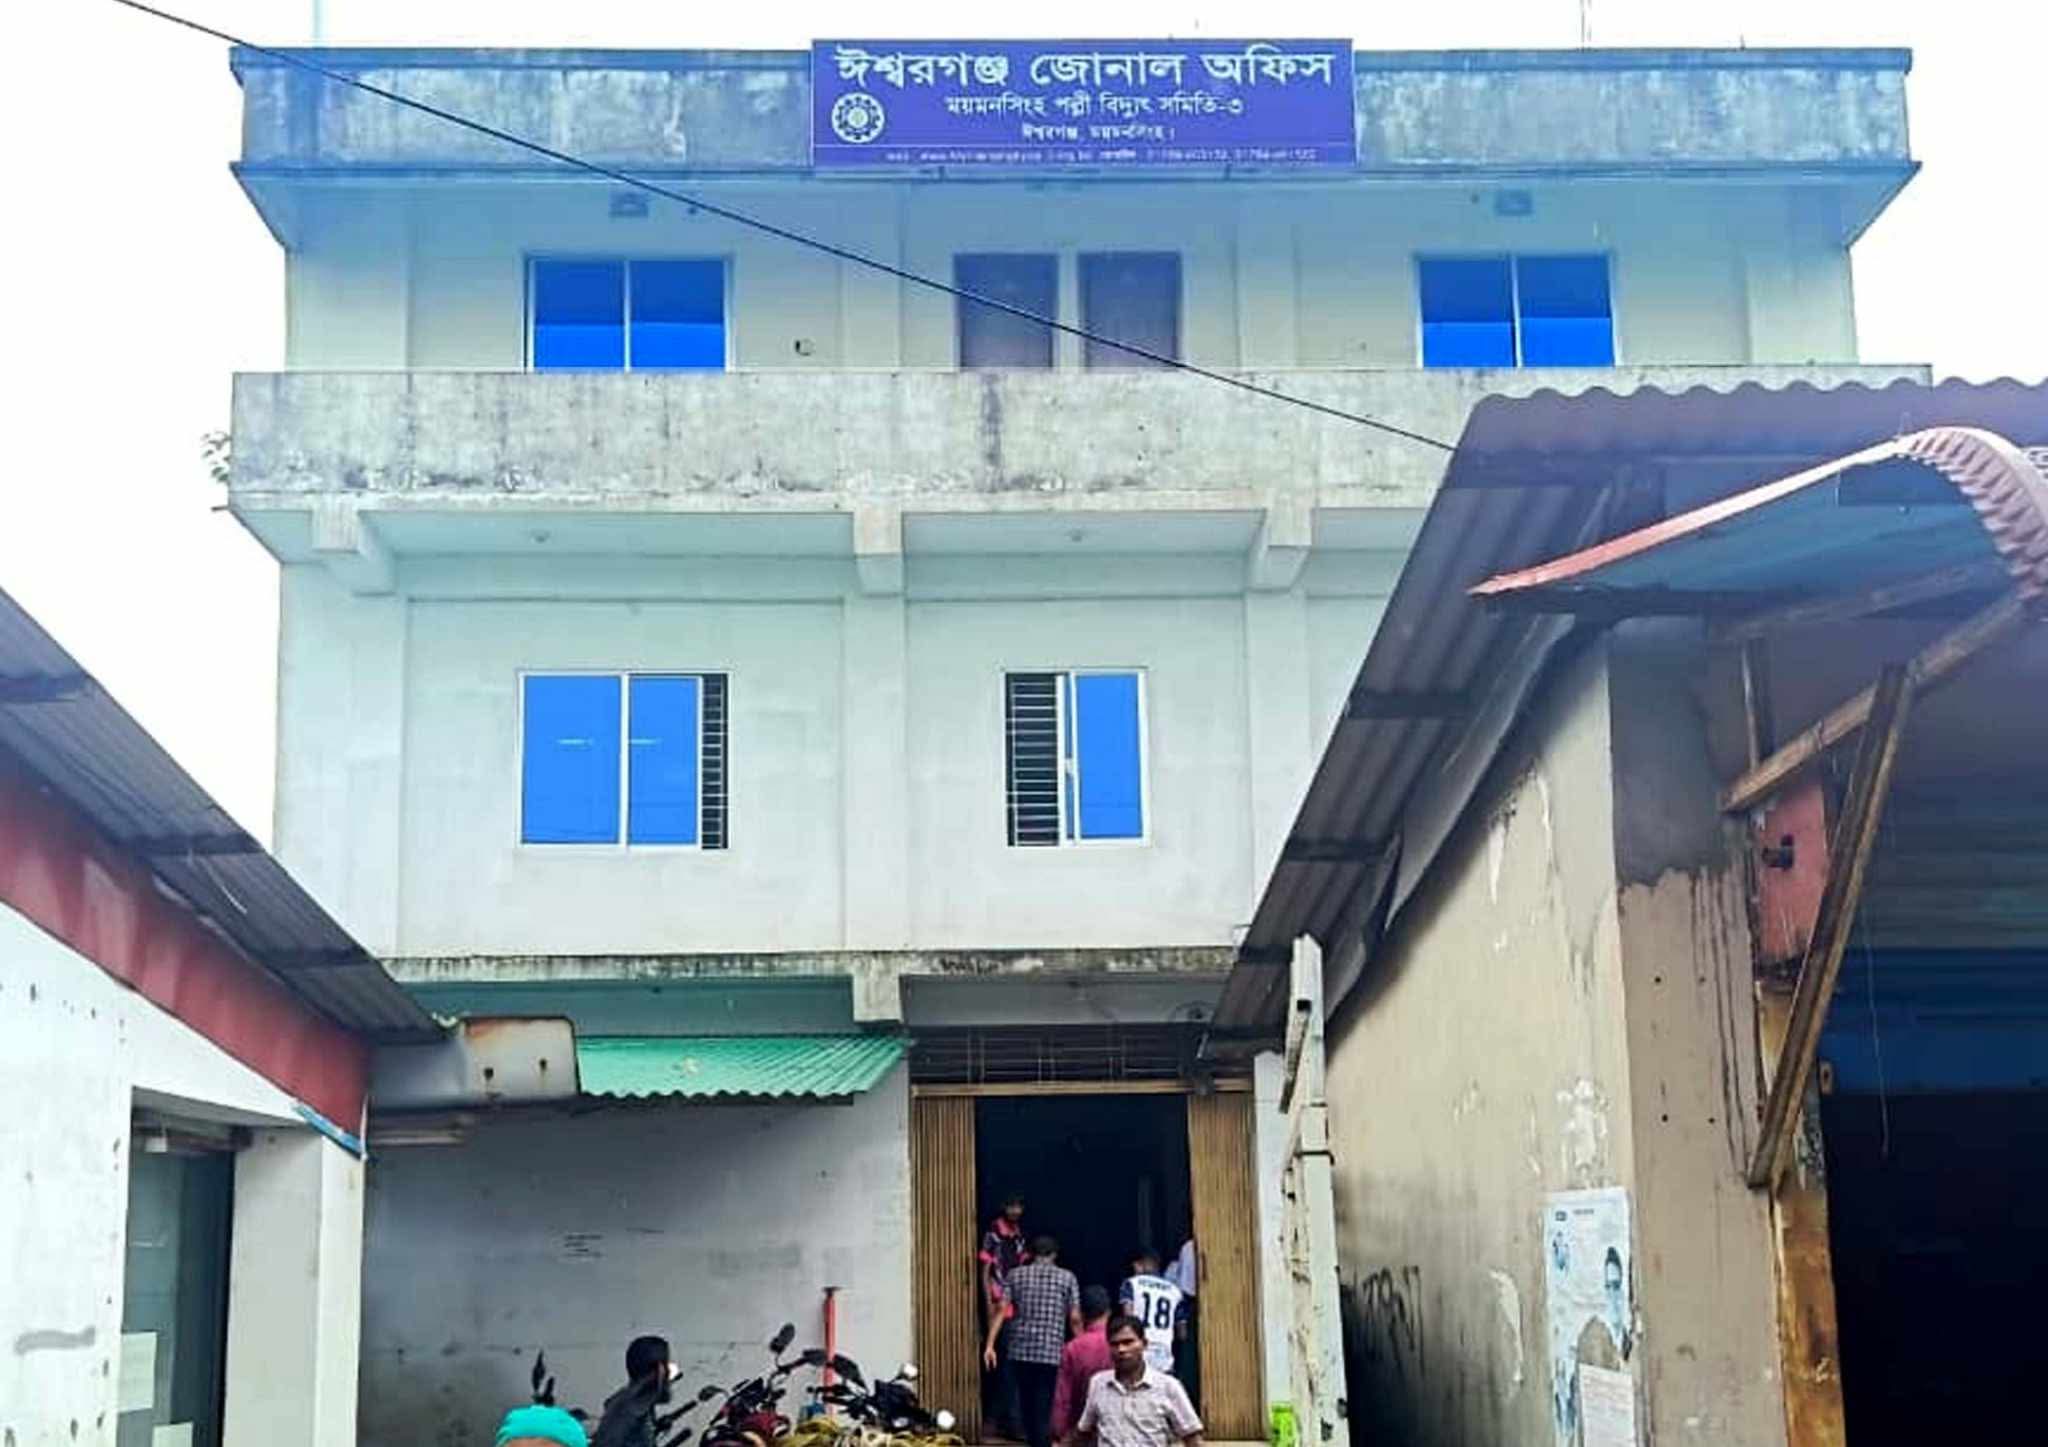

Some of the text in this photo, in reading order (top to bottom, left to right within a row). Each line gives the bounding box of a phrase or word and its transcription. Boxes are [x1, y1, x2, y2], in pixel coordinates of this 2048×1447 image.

[834, 43, 1336, 88] ঈশ্বরগঞ্জ জোনাল অফিস
[945, 92, 1048, 116] ময়মনসিংহ
[1054, 89, 1091, 117] পল্লী
[1141, 1290, 1171, 1330] 18
